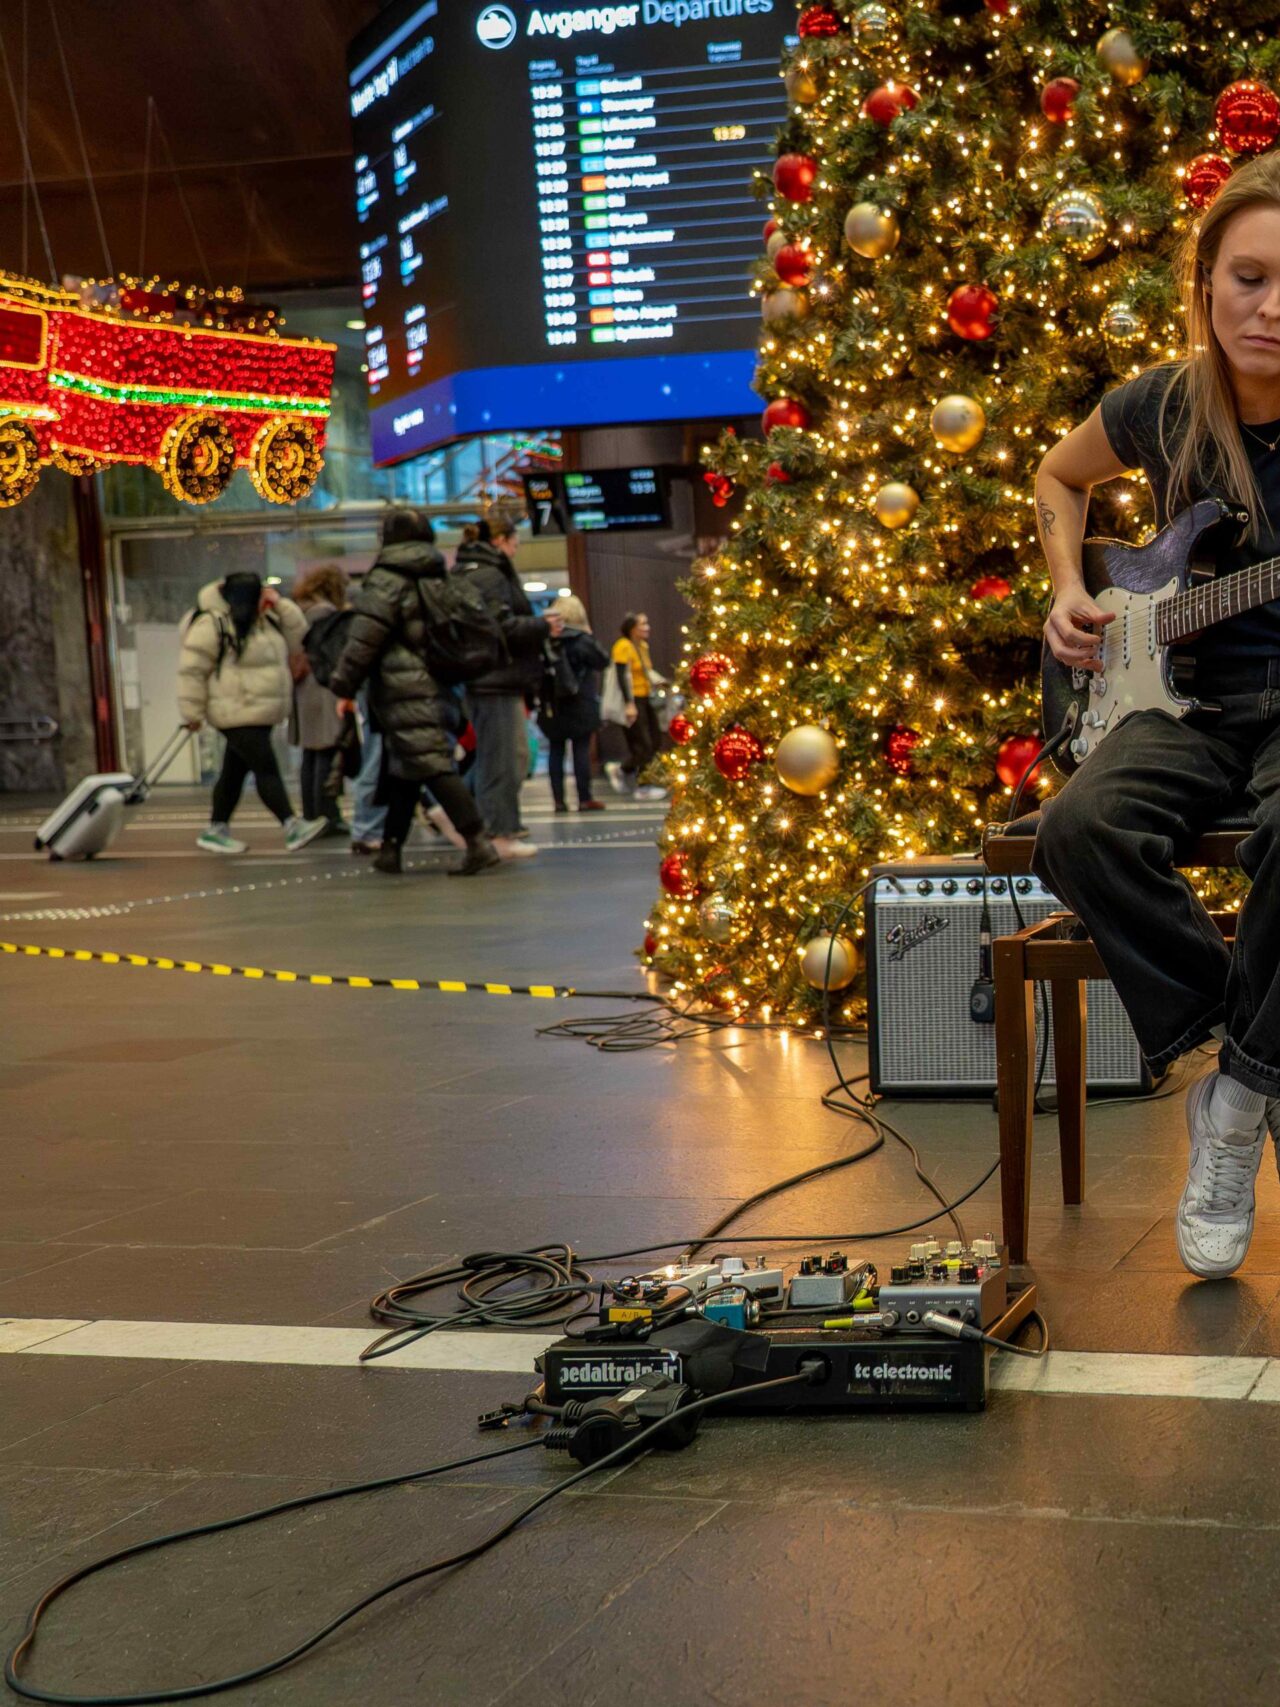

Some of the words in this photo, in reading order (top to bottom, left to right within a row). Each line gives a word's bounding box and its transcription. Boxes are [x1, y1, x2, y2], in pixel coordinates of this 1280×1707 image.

[527, 4, 640, 38] Avganger
[642, 0, 774, 28] Departures
[536, 501, 552, 526] 7
[886, 914, 950, 962] Fender
[854, 1362, 871, 1379] tc
[872, 1362, 953, 1380] electronic
